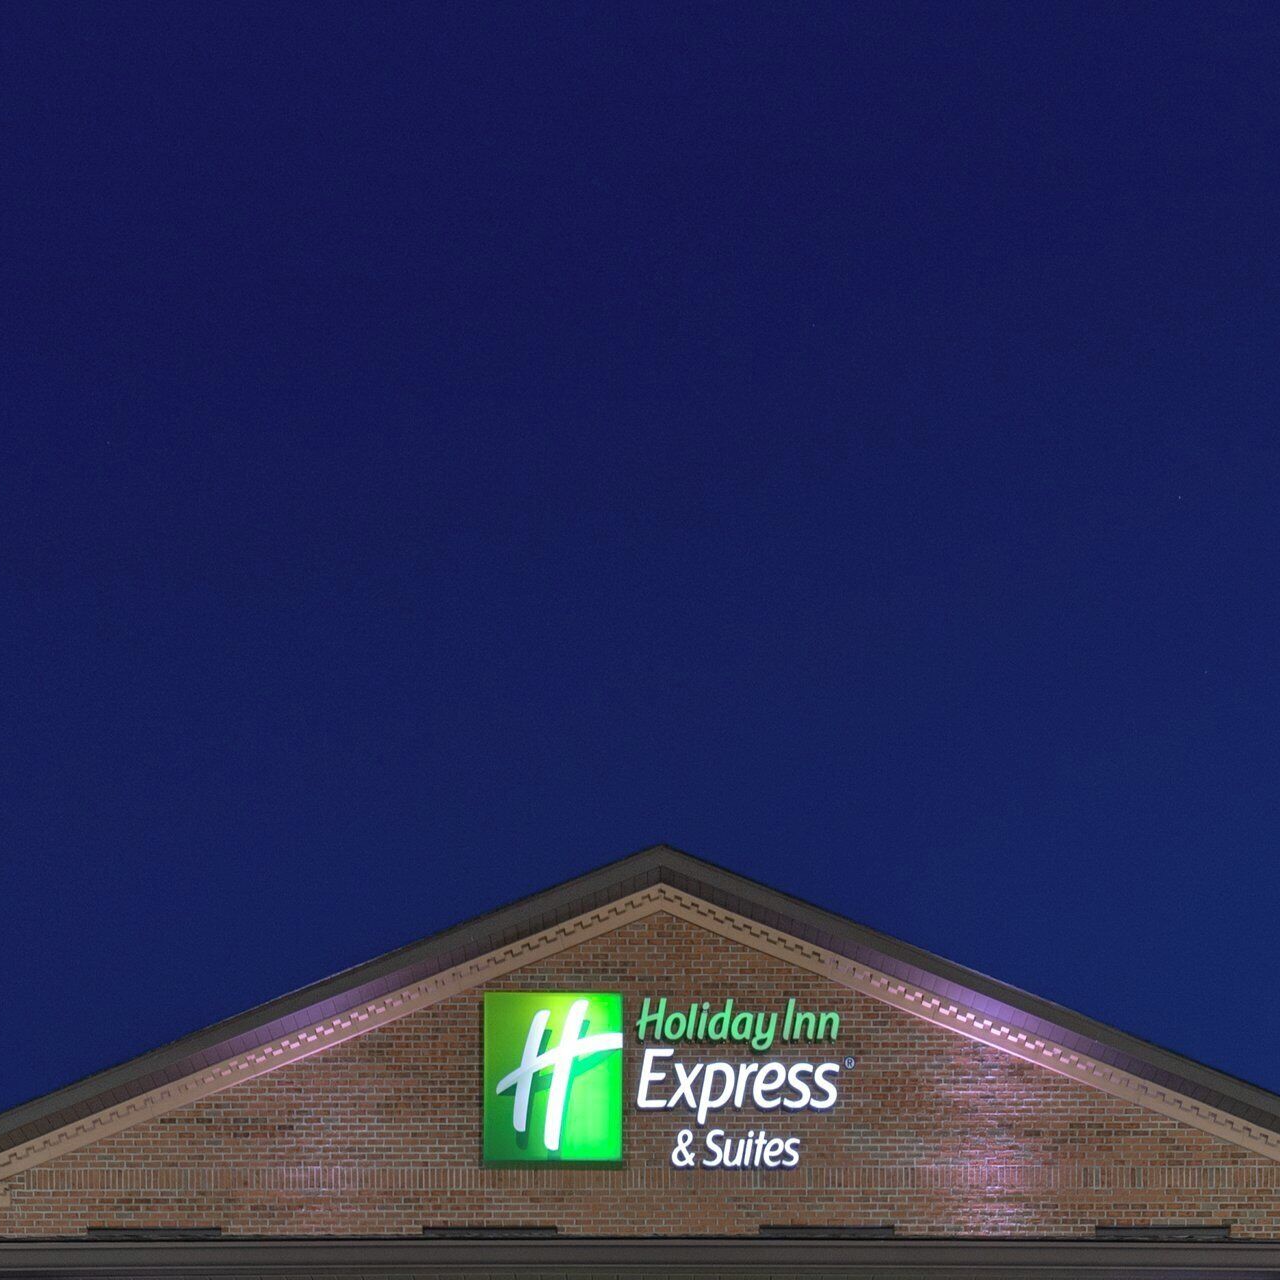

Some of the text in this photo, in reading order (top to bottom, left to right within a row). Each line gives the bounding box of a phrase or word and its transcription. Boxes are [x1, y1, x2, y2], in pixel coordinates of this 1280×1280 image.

[636, 998, 840, 1050] Holiday Inn
[636, 1048, 840, 1126] Express
[671, 1129, 801, 1167] & Suites
